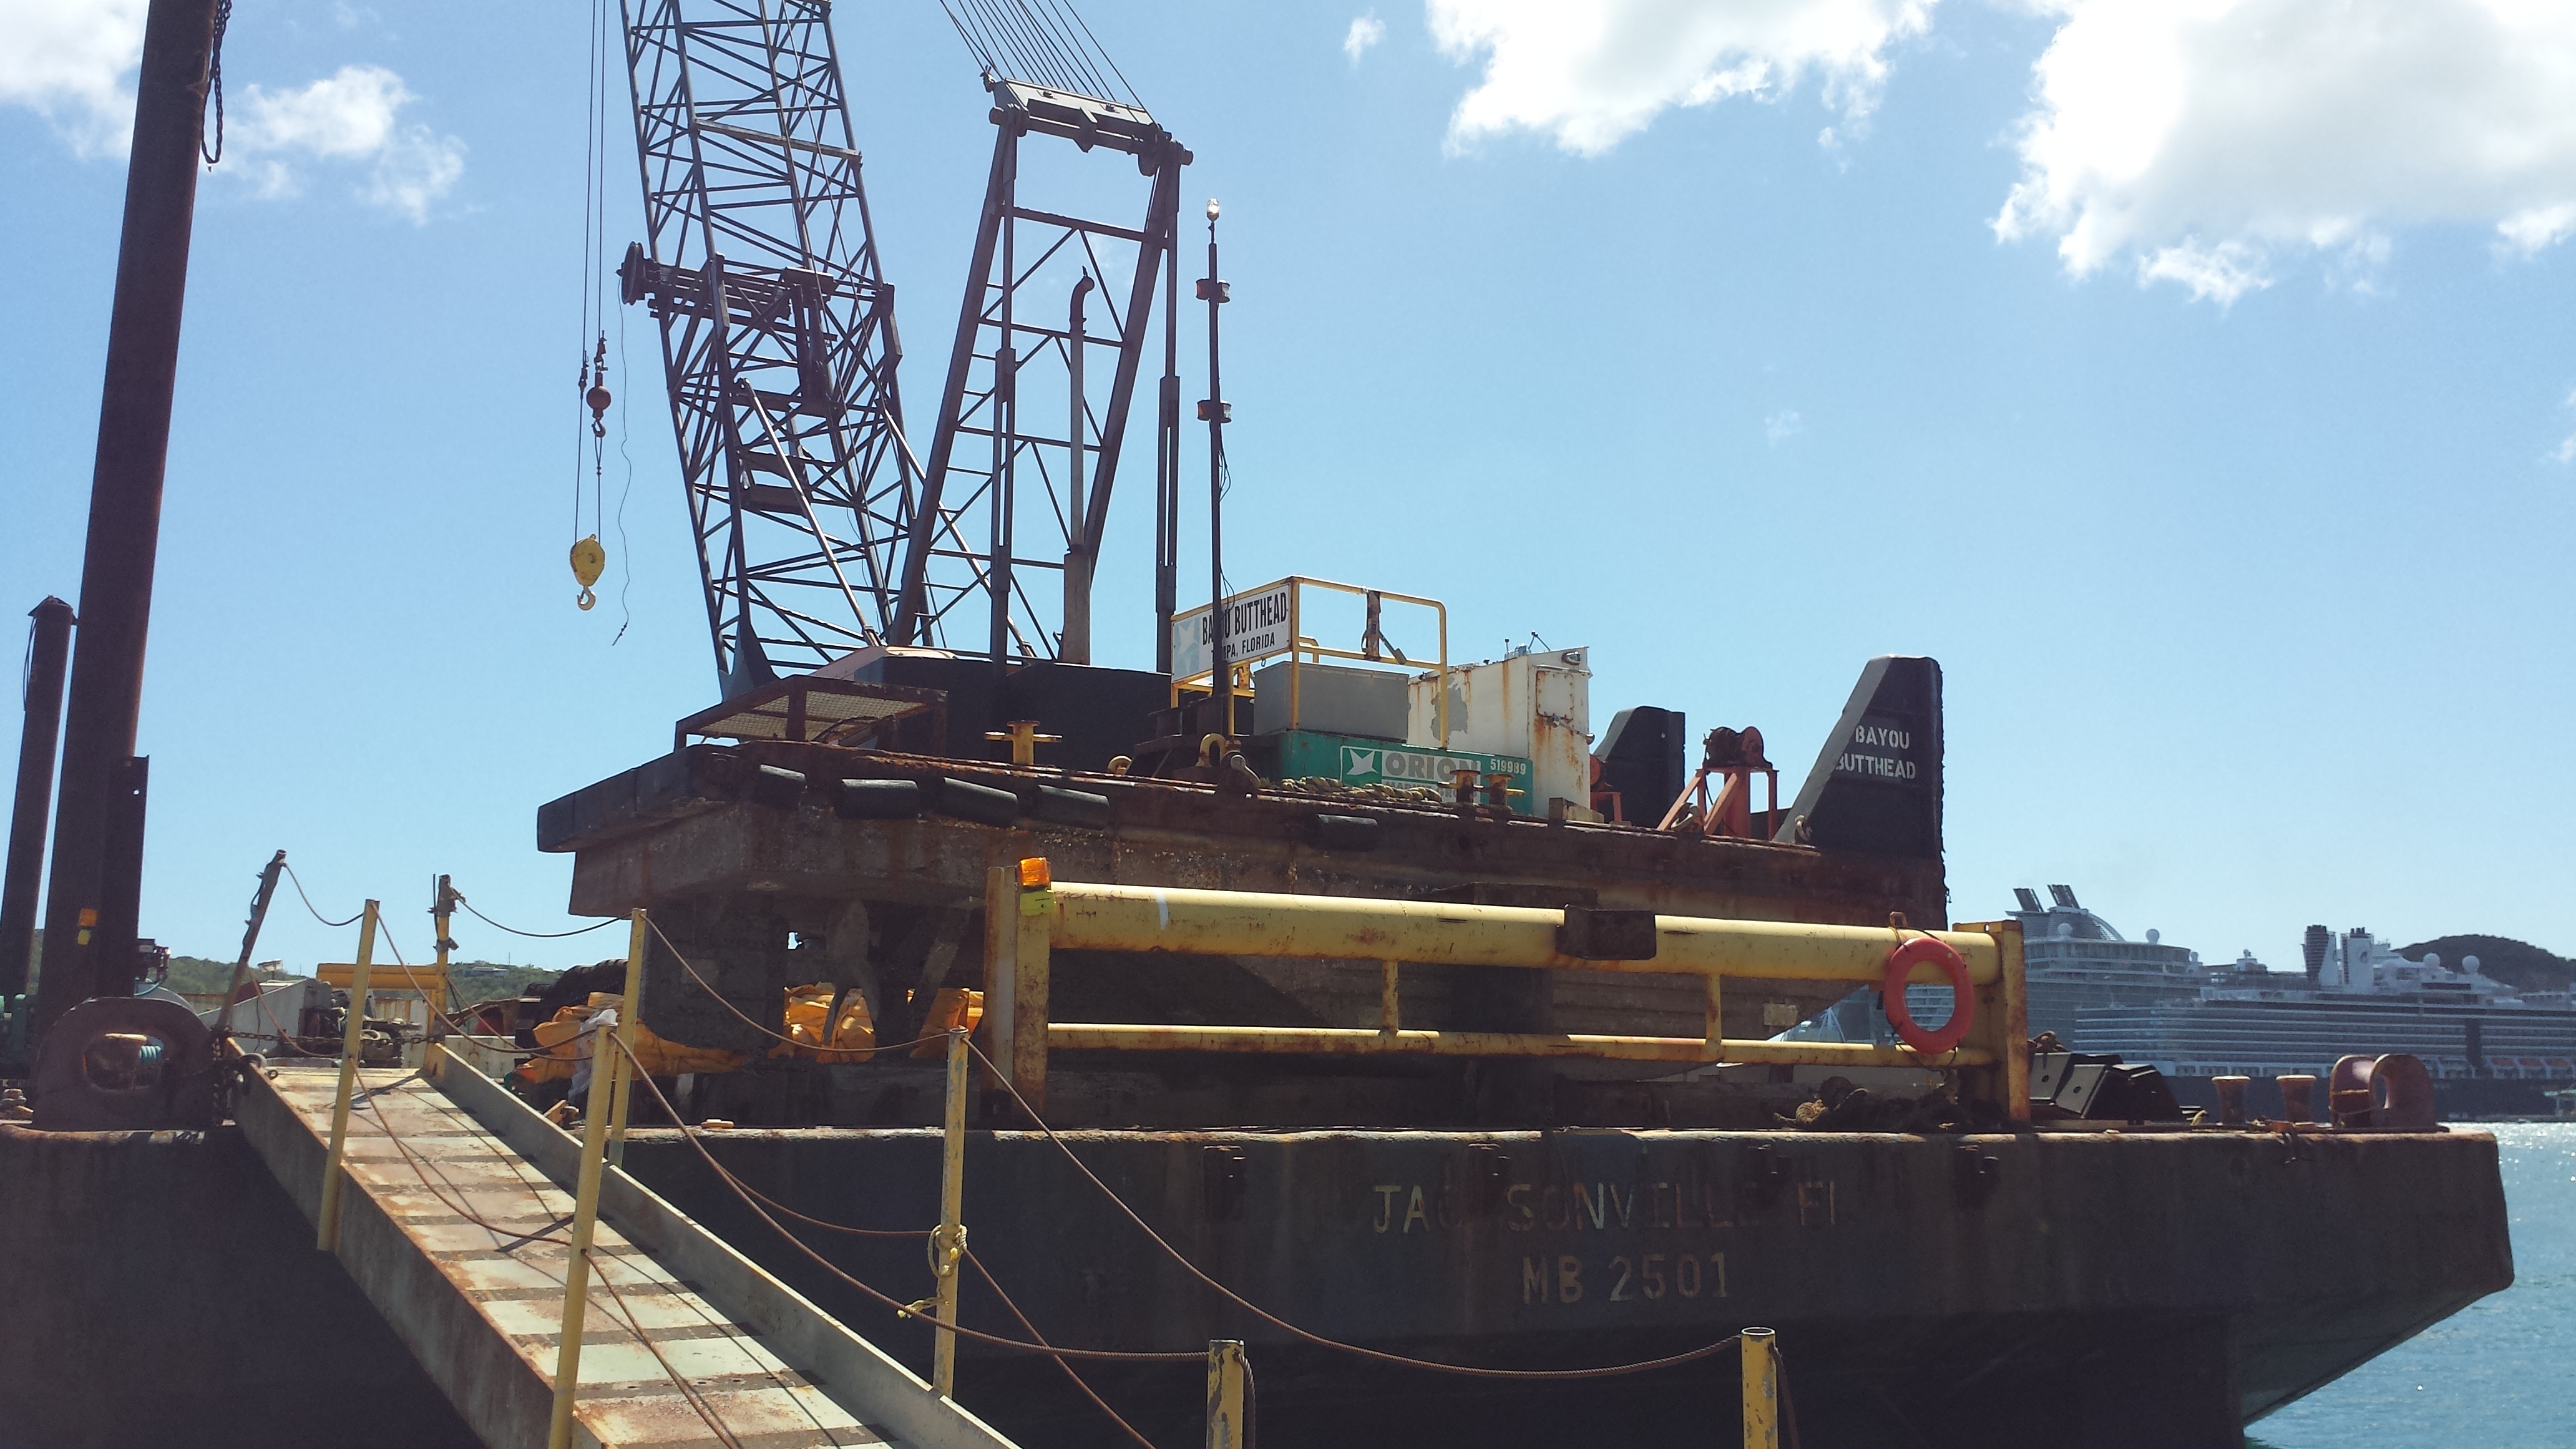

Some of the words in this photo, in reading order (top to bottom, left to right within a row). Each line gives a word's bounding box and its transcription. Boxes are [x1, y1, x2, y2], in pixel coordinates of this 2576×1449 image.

[1203, 609, 1231, 645] BAU
[1234, 592, 1287, 636] BUTTHEAD
[1242, 632, 1276, 655] FLORIDA
[1855, 725, 1910, 749] BAYOU
[1385, 752, 1478, 783] ORION
[1490, 758, 1526, 776] 519989
[1372, 1181, 1760, 1234] JACSONVILL
[1521, 1256, 1584, 1305] MB
[1608, 1251, 1728, 1303] 2501
